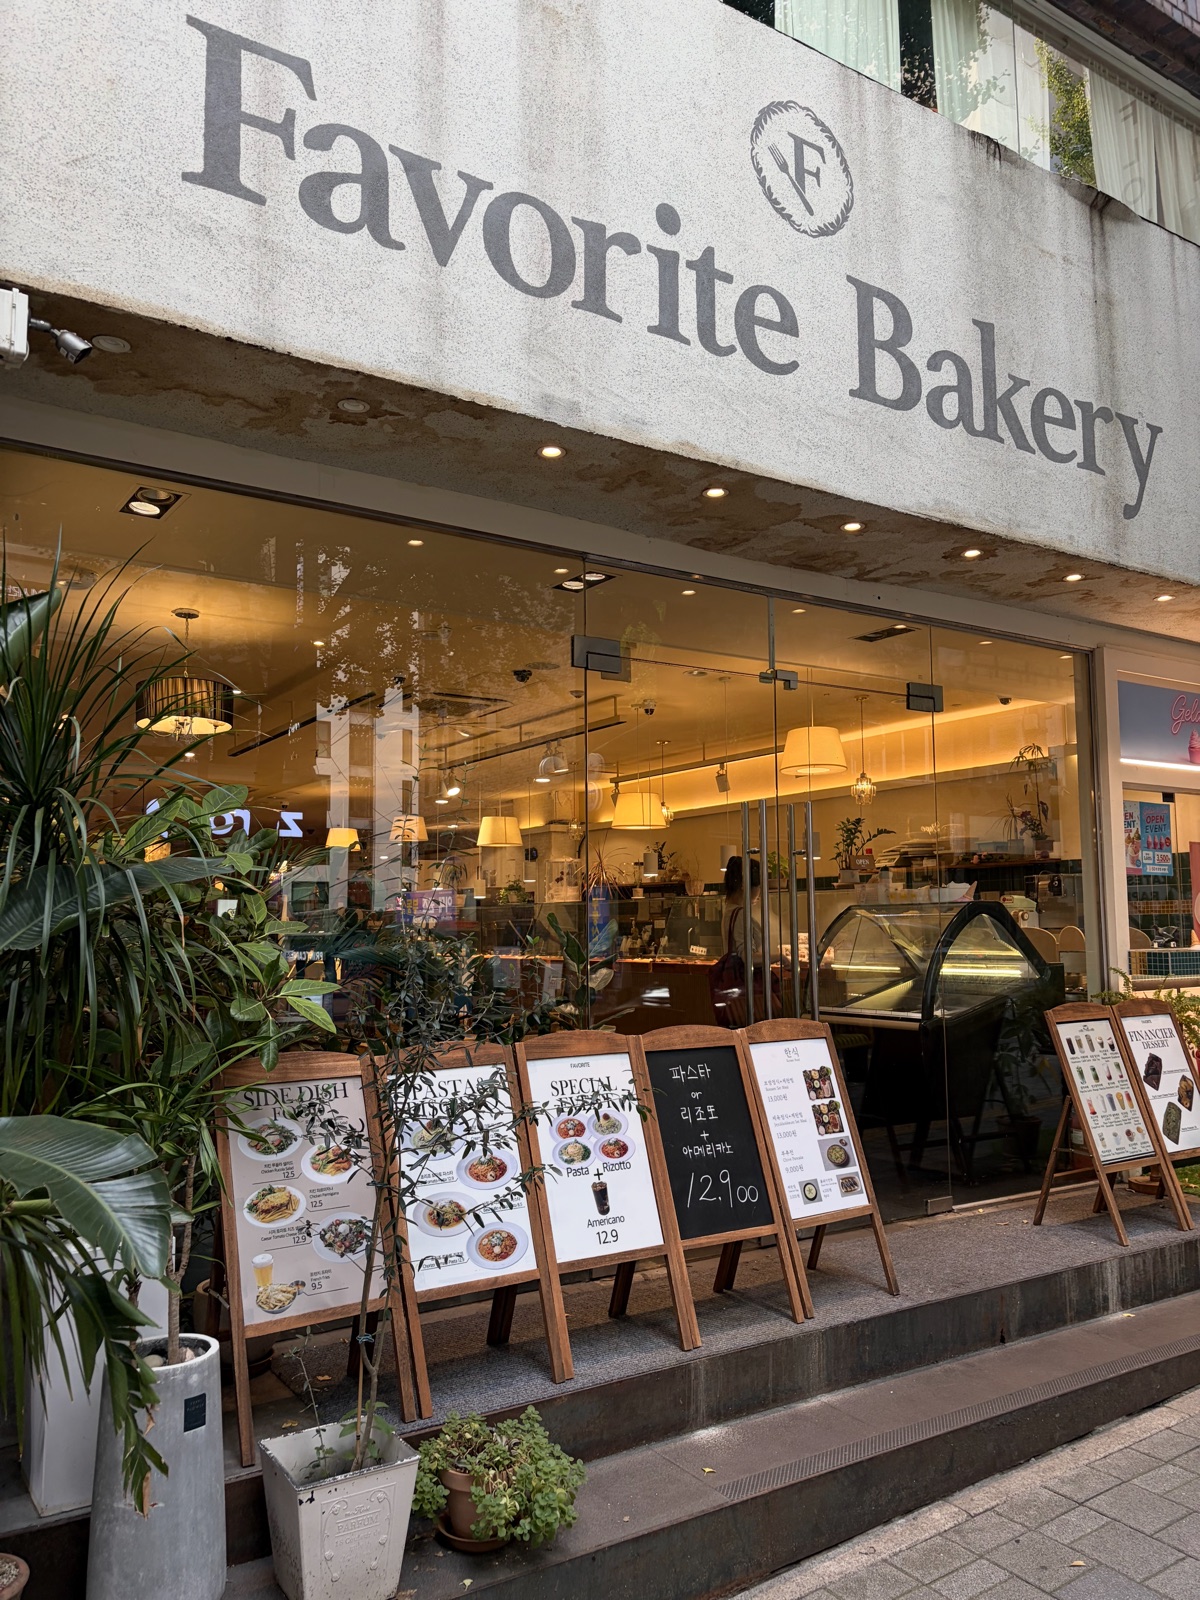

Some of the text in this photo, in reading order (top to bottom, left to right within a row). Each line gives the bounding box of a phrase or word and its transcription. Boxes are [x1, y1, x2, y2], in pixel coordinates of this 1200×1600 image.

[787, 131, 827, 193] F
[181, 14, 1163, 520] Favorite Bakery
[1146, 815, 1165, 824] OPEN
[1145, 824, 1167, 833] EVENT
[1128, 1027, 1176, 1042] FINANCIER
[1142, 1039, 1170, 1050] DESSERT
[784, 1047, 800, 1058] 한식
[669, 1063, 712, 1083] 파스타
[550, 1076, 618, 1097] SPECIAL
[243, 1082, 349, 1107] SIDE DISH
[691, 1091, 702, 1100] or
[680, 1105, 719, 1124] 리조또
[682, 1142, 734, 1159] 아메리카노
[282, 1171, 295, 1179] 12.5
[566, 1166, 589, 1178] Pasta
[602, 1161, 632, 1172] Rizotto
[310, 1200, 323, 1208] 12.5
[587, 1215, 625, 1228] Americano
[292, 1235, 307, 1244] 12.9
[596, 1229, 619, 1245] 12.9
[311, 1281, 323, 1291] 9.5
[337, 1515, 379, 1532] PARFUM
